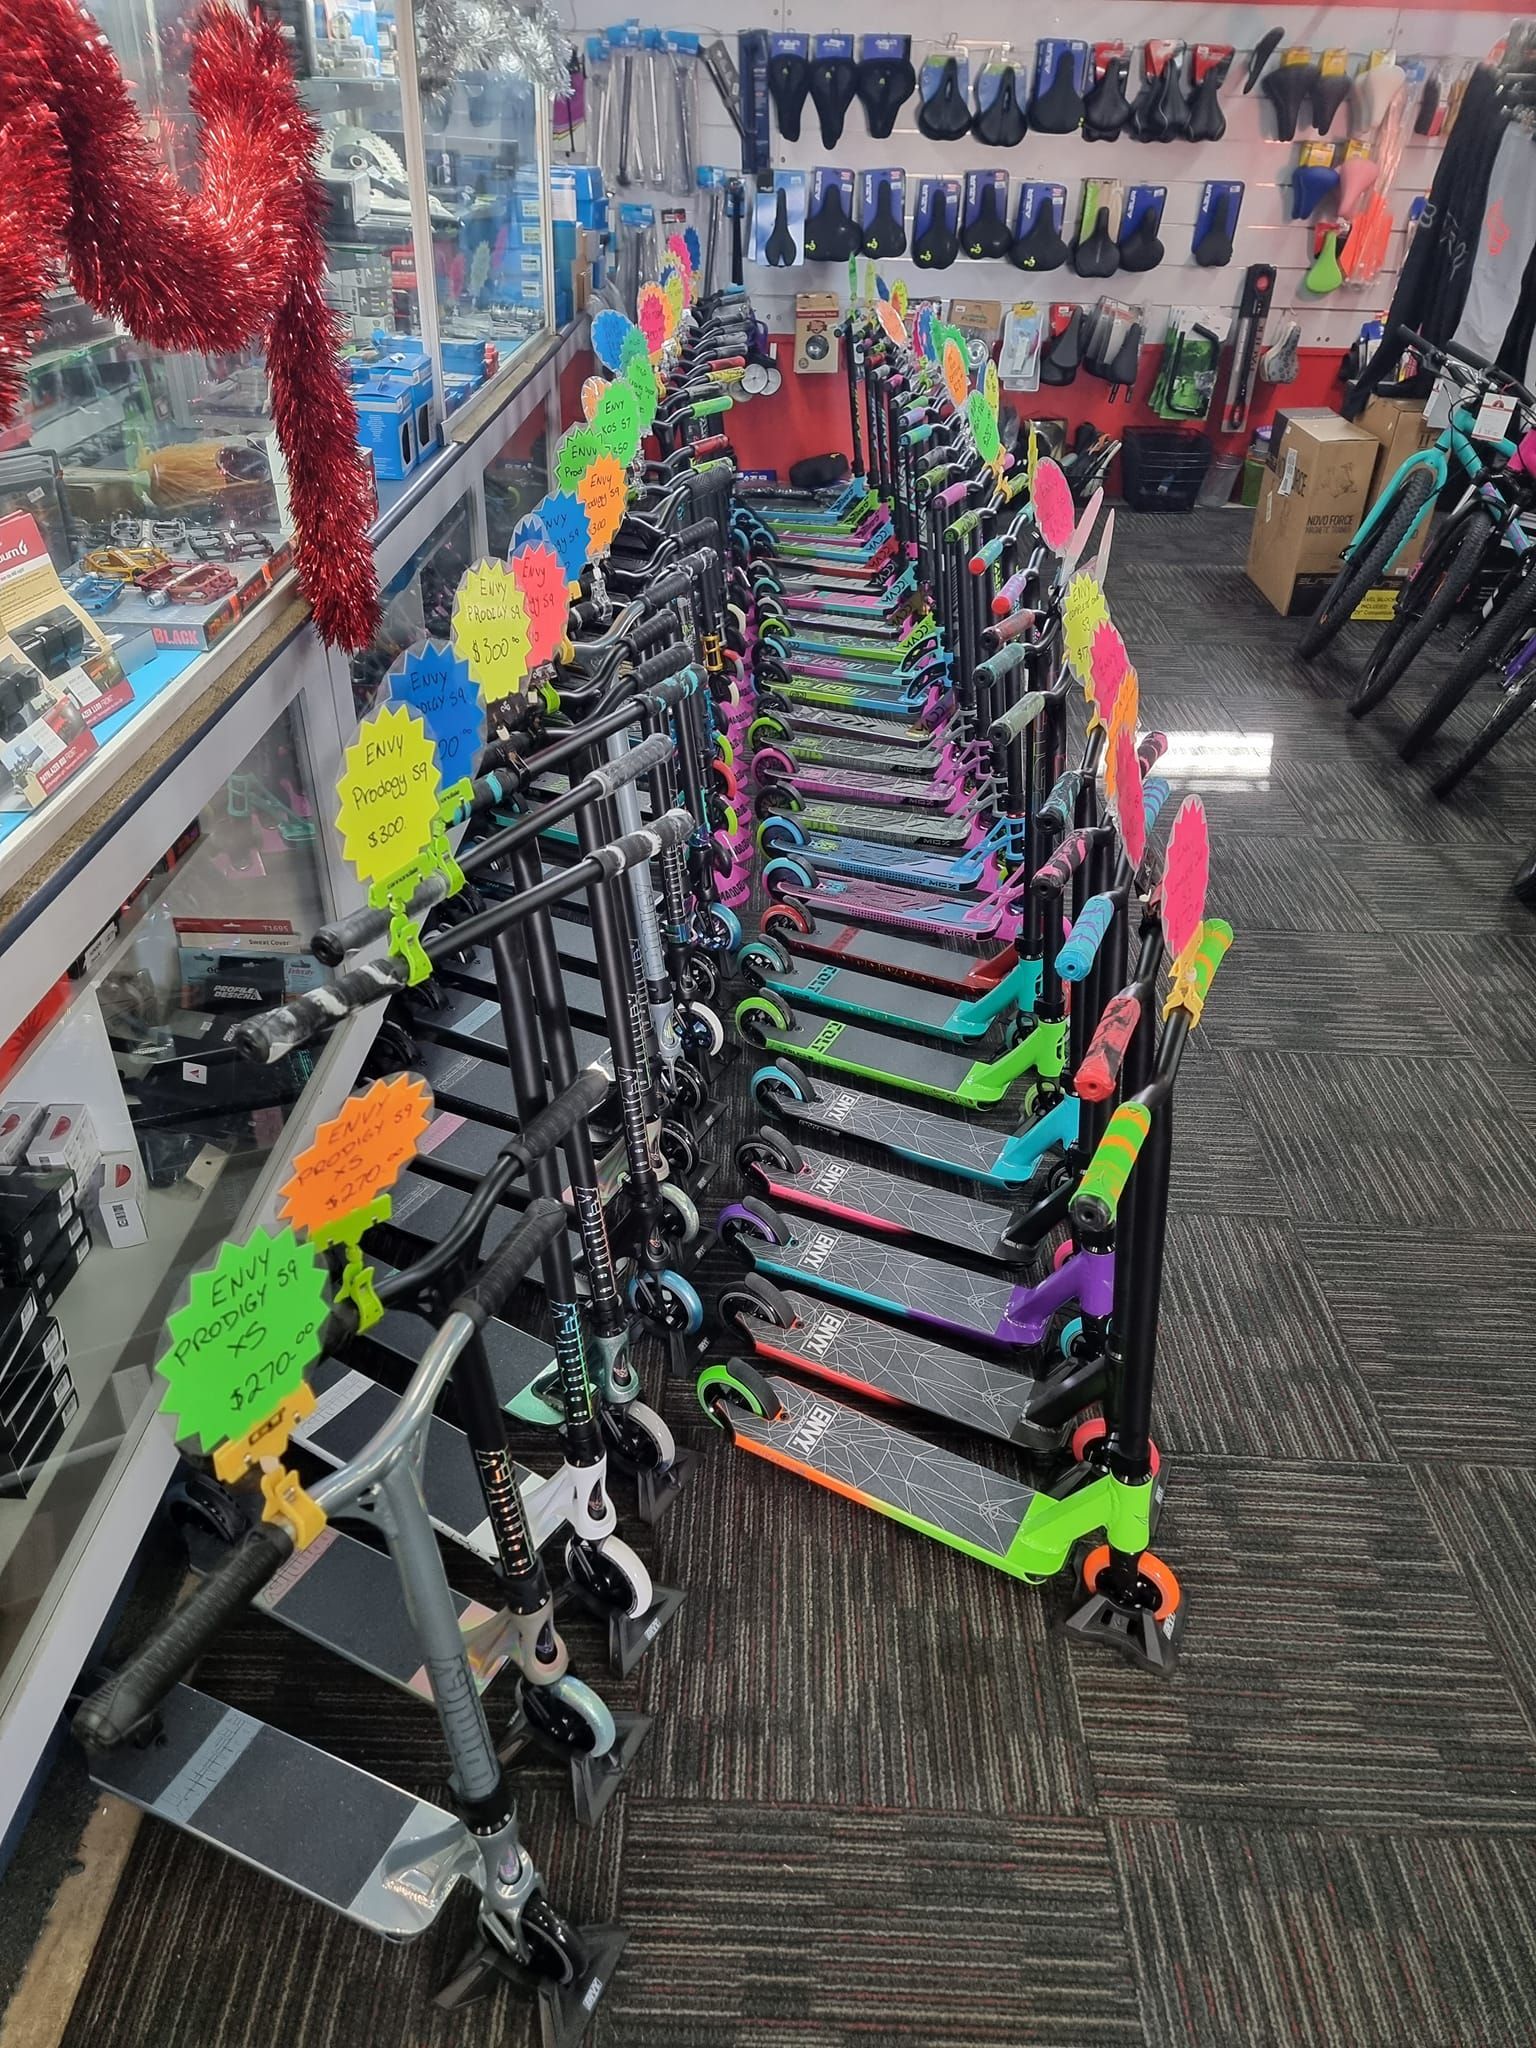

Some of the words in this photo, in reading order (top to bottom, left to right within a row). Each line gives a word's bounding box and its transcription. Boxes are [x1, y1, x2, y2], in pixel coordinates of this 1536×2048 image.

[605, 400, 624, 414] ENVY
[590, 473, 612, 488] ENVY
[152, 627, 199, 646] BLACK
[410, 672, 447, 691] ENVY
[365, 733, 404, 766] ENVY
[213, 984, 254, 995] PROFILE
[213, 991, 252, 1000] DESIGN
[328, 1093, 391, 1145] ENVY
[297, 1120, 384, 1187] PRODIGY
[212, 1248, 270, 1308] ENVY
[174, 1284, 267, 1367] PRODIGY
[227, 1321, 267, 1359] XS
